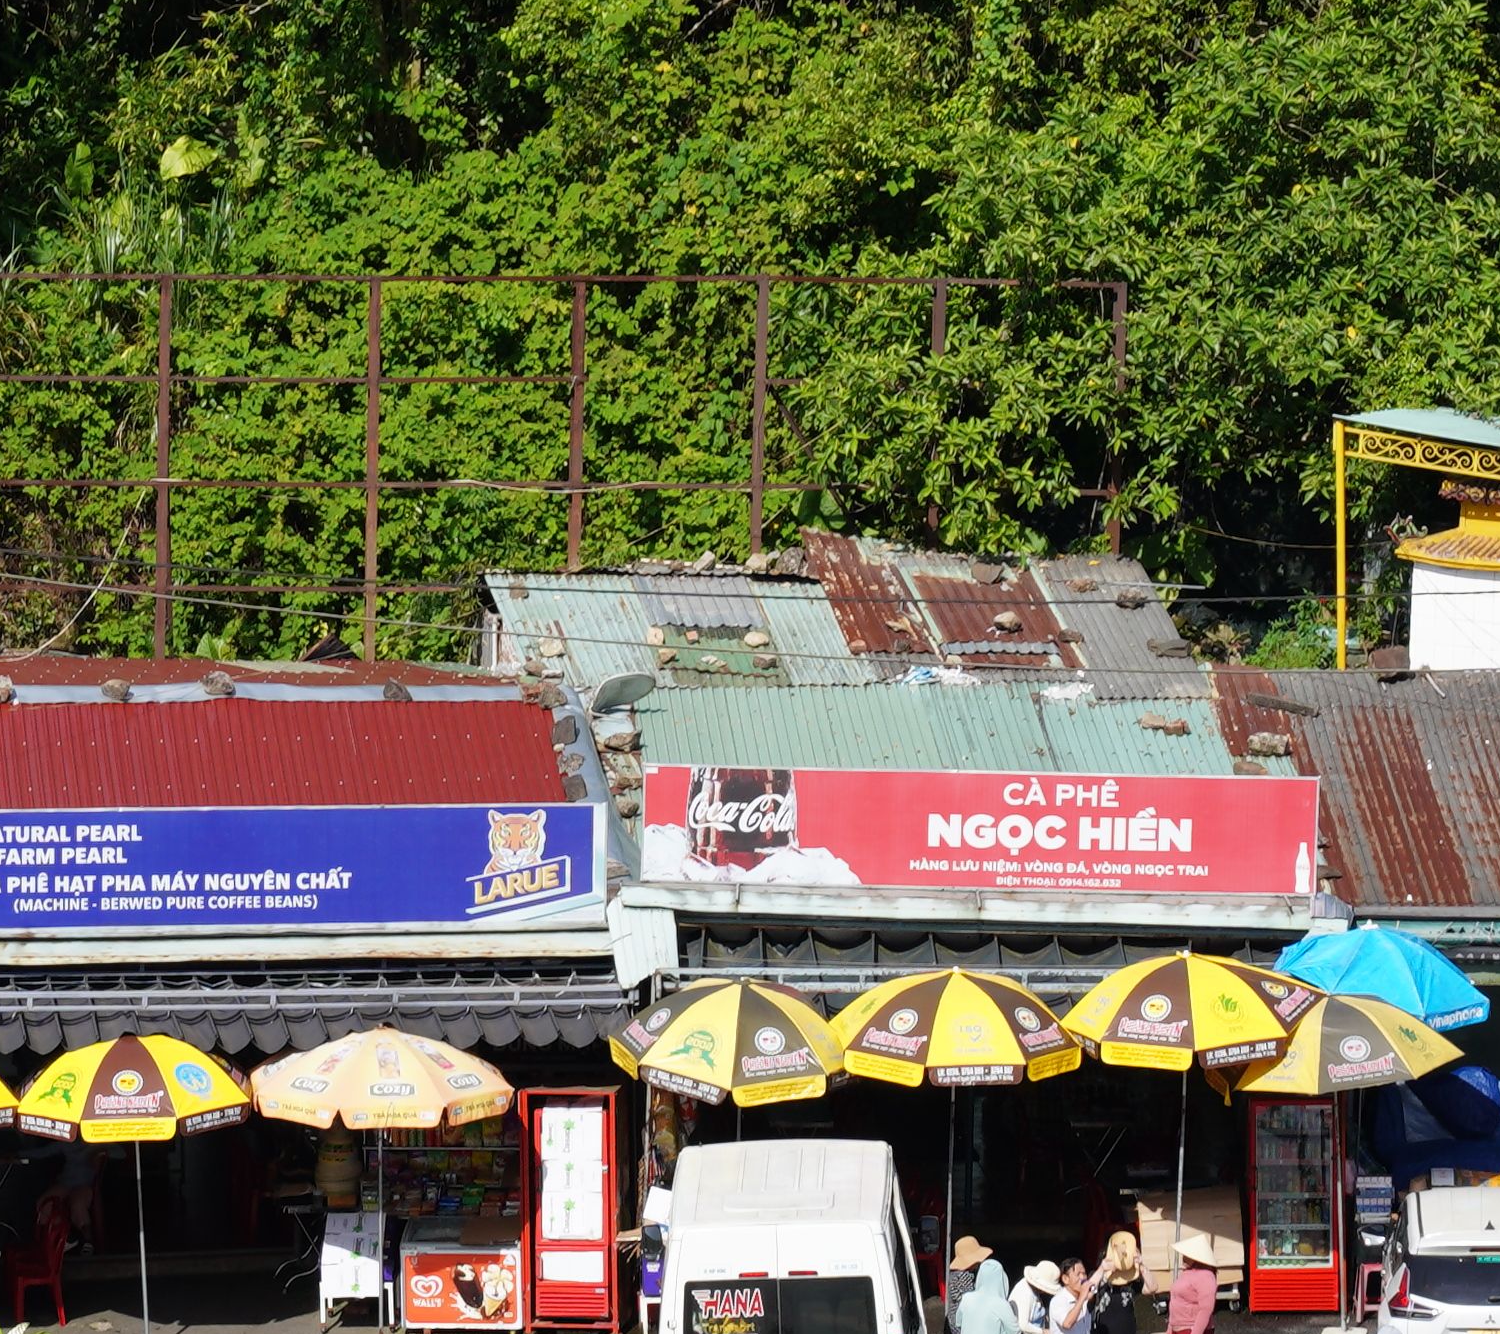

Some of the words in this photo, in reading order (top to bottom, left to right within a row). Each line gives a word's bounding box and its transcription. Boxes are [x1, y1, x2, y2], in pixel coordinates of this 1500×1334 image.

[1003, 777, 1047, 806] CÀ
[1056, 779, 1120, 807] PHÊ
[689, 793, 795, 833] Coca-Cola
[76, 825, 142, 842] PEARL
[927, 813, 1068, 856] NGỌC
[62, 847, 127, 864] PEARL
[909, 857, 948, 871] HÀNG
[952, 859, 981, 871] LƯU
[983, 860, 1021, 875] NIỆM:
[1024, 859, 1062, 873] VÒNG
[1066, 860, 1090, 875] ĐÁ,
[1094, 860, 1131, 875] VÒNG
[1135, 864, 1174, 877] NGỌC
[1177, 866, 1208, 876] TRAI
[7, 873, 48, 894] PHÊ
[54, 876, 96, 896] HẠT
[103, 874, 145, 892] PHA
[151, 870, 199, 892] MÁY
[204, 869, 290, 891] NGUYÊN
[296, 867, 352, 890] CHẤT
[474, 864, 560, 905] LARUE
[13, 898, 88, 914] (MACHINE
[101, 897, 161, 912] BERWED
[166, 896, 204, 911] PURE
[208, 896, 260, 911] COFFEE
[265, 894, 319, 911] BEANS)
[373, 1083, 411, 1097] Cozy
[451, 1074, 479, 1088] Cozy
[692, 1288, 764, 1318] HANA
